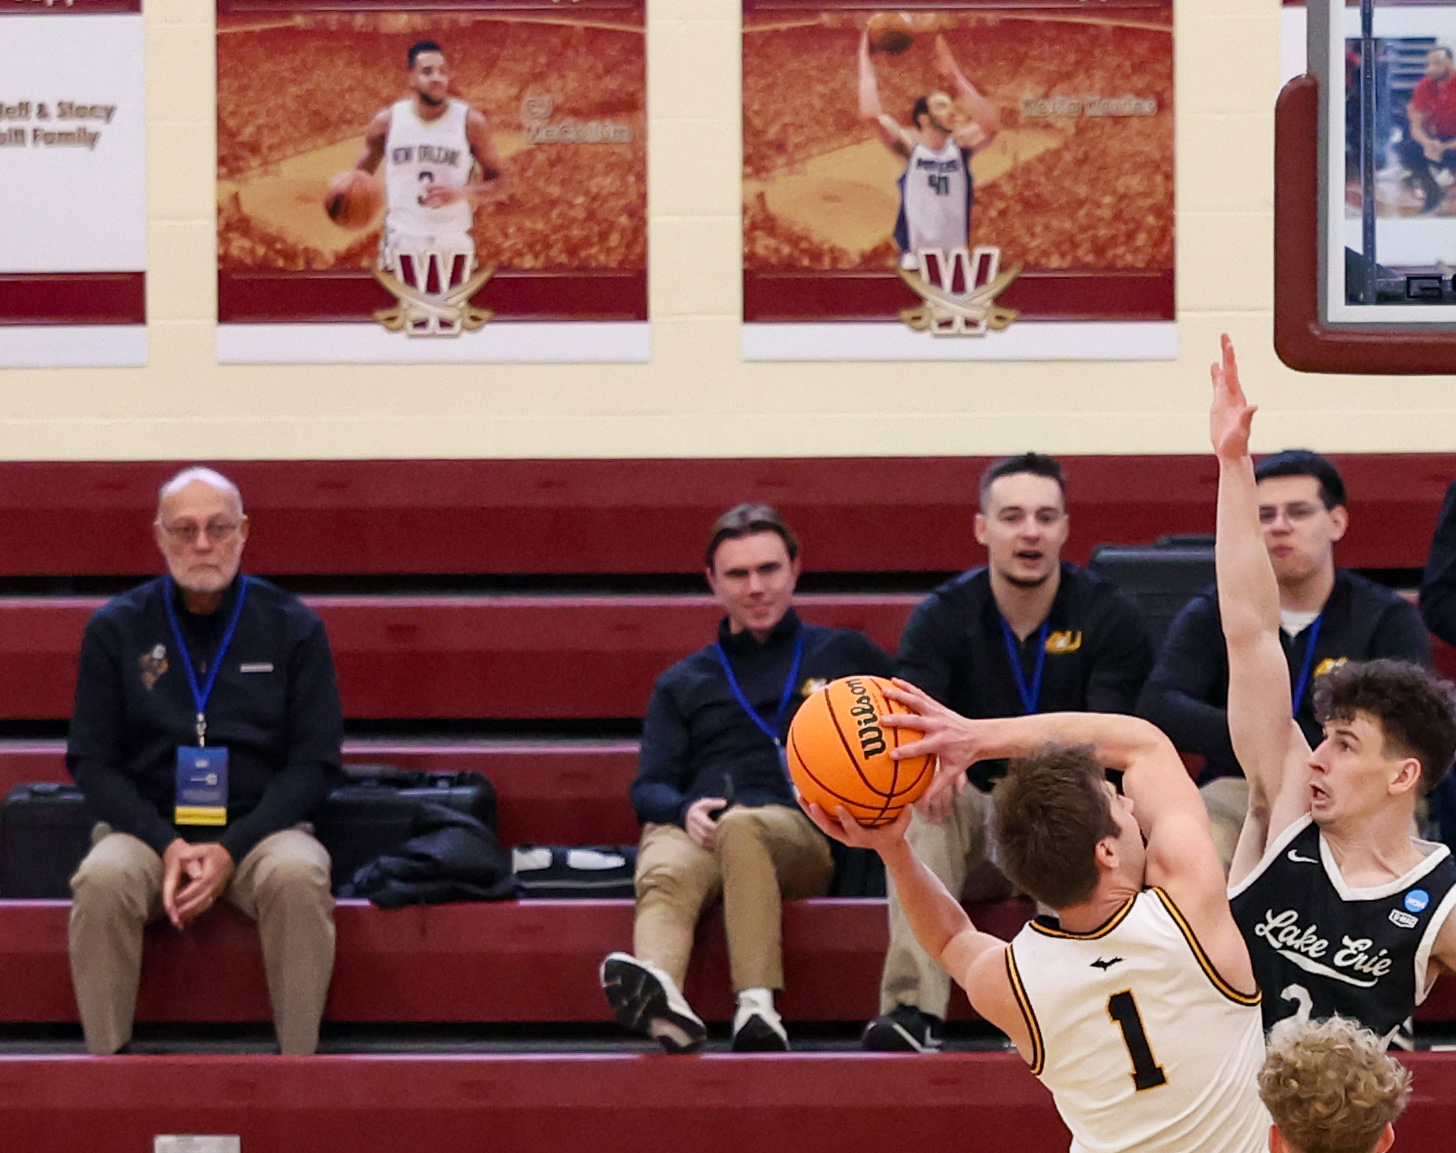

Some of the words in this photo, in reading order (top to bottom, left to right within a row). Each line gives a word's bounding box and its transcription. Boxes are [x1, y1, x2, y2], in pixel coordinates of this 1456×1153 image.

[845, 678, 887, 761] Wilson
[1254, 908, 1330, 958] Lake
[1333, 935, 1393, 977] Erie
[1105, 987, 1169, 1092] 1
